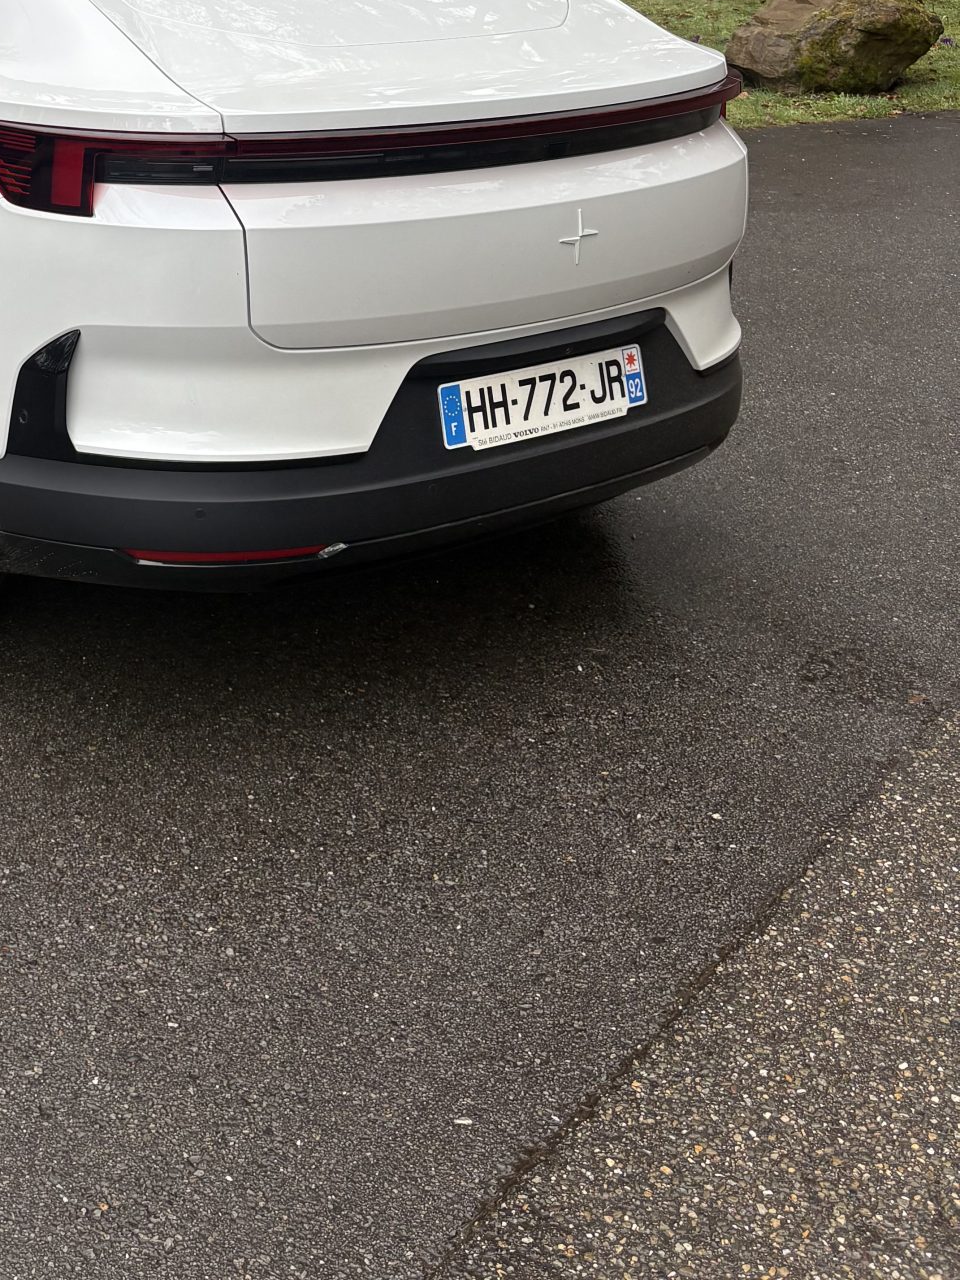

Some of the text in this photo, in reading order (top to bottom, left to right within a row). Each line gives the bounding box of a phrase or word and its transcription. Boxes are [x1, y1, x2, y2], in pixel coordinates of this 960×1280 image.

[464, 358, 626, 433] HH-772-JR
[628, 377, 643, 398] 92
[450, 422, 458, 436] F
[512, 427, 540, 438] VOLVO
